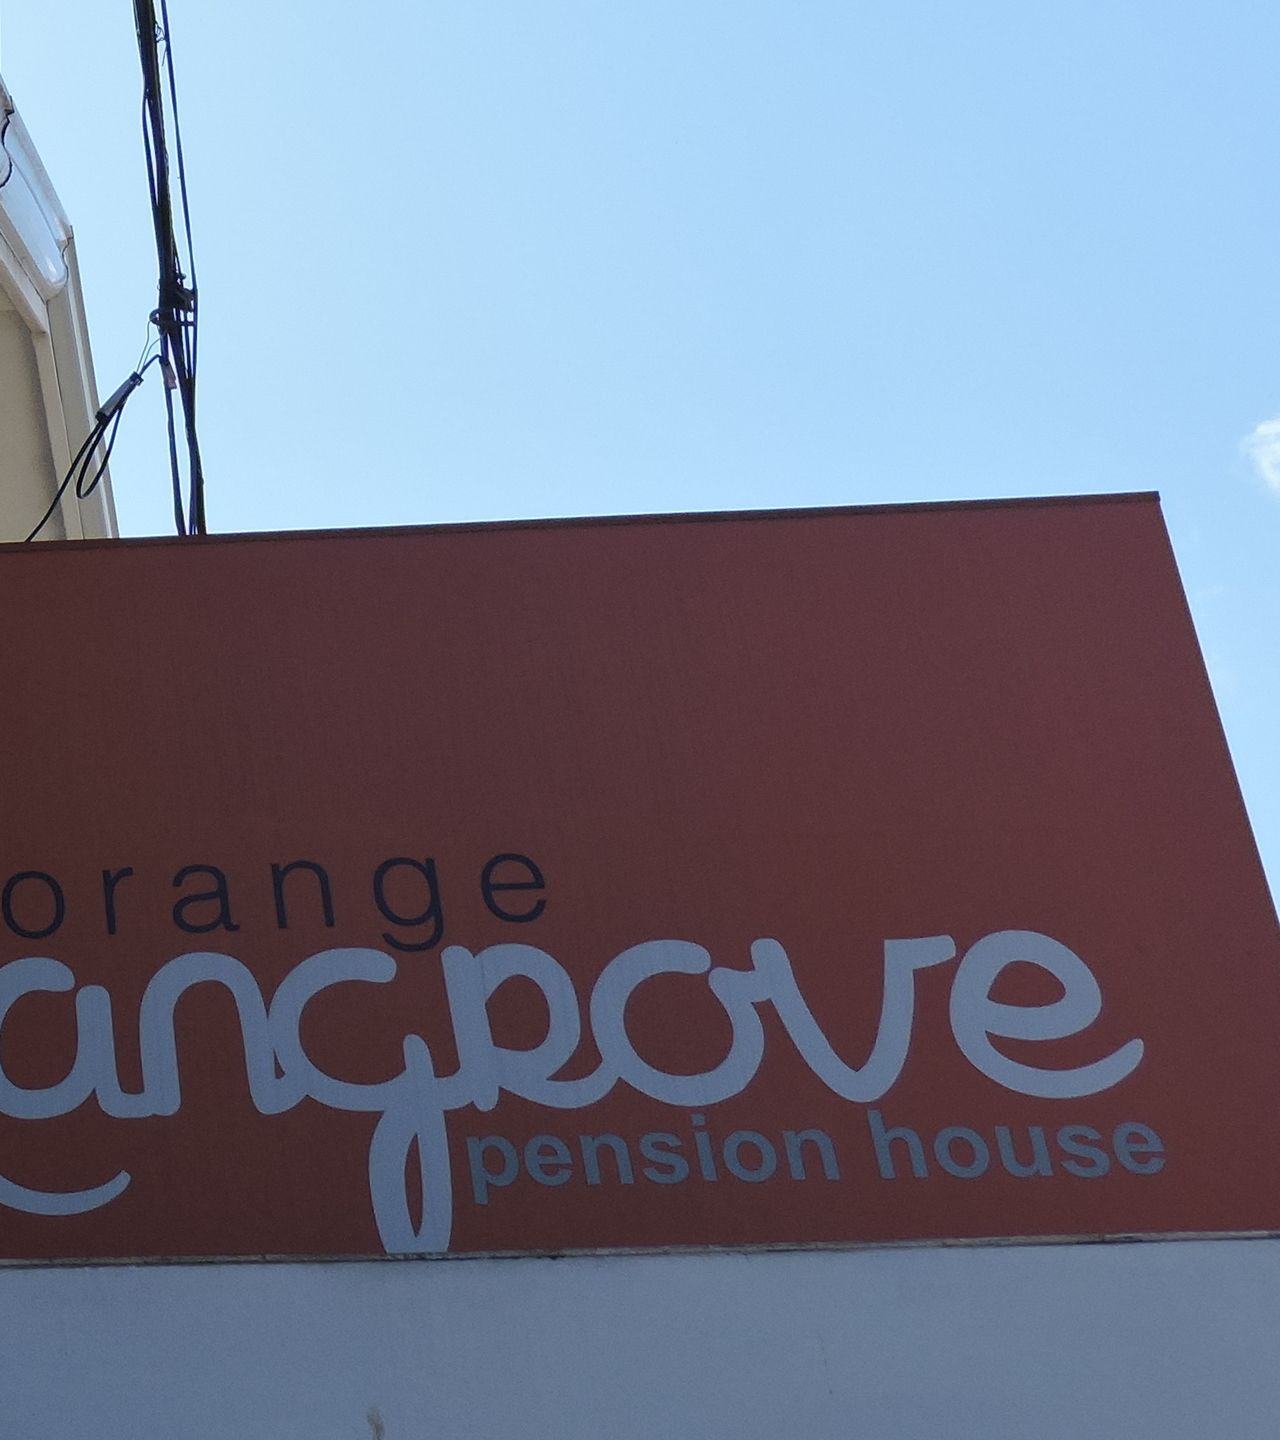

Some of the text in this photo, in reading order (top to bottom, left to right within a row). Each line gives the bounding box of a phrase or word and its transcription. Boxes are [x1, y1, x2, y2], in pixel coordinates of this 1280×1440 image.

[2, 851, 548, 952] orange
[466, 1107, 1168, 1205] pension house
